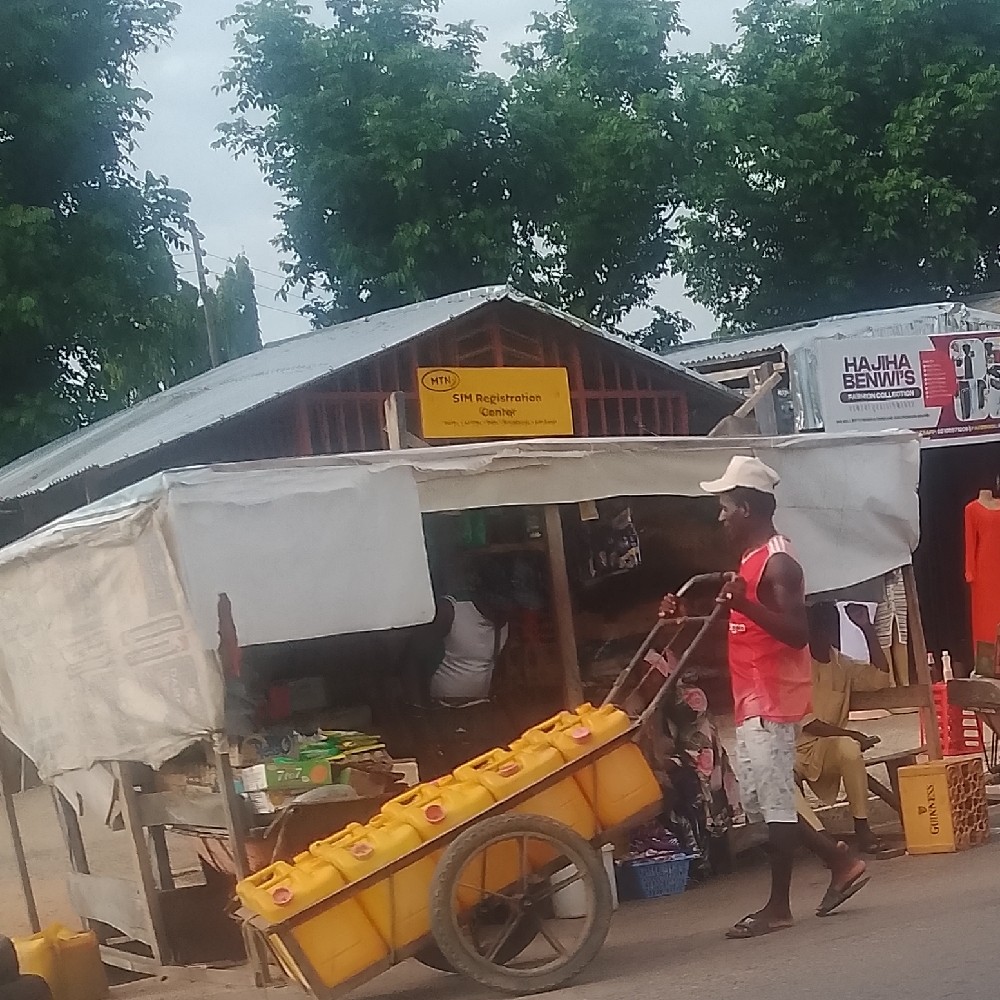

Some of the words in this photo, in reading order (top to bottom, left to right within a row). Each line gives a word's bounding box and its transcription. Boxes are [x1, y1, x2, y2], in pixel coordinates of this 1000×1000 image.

[843, 353, 913, 373] HAJIHA
[430, 375, 452, 386] MTN
[842, 370, 917, 390] BENWI'S
[452, 393, 473, 403] SIM
[475, 392, 542, 405] Registration
[479, 407, 517, 418] Center
[926, 784, 940, 835] GUINNESS
